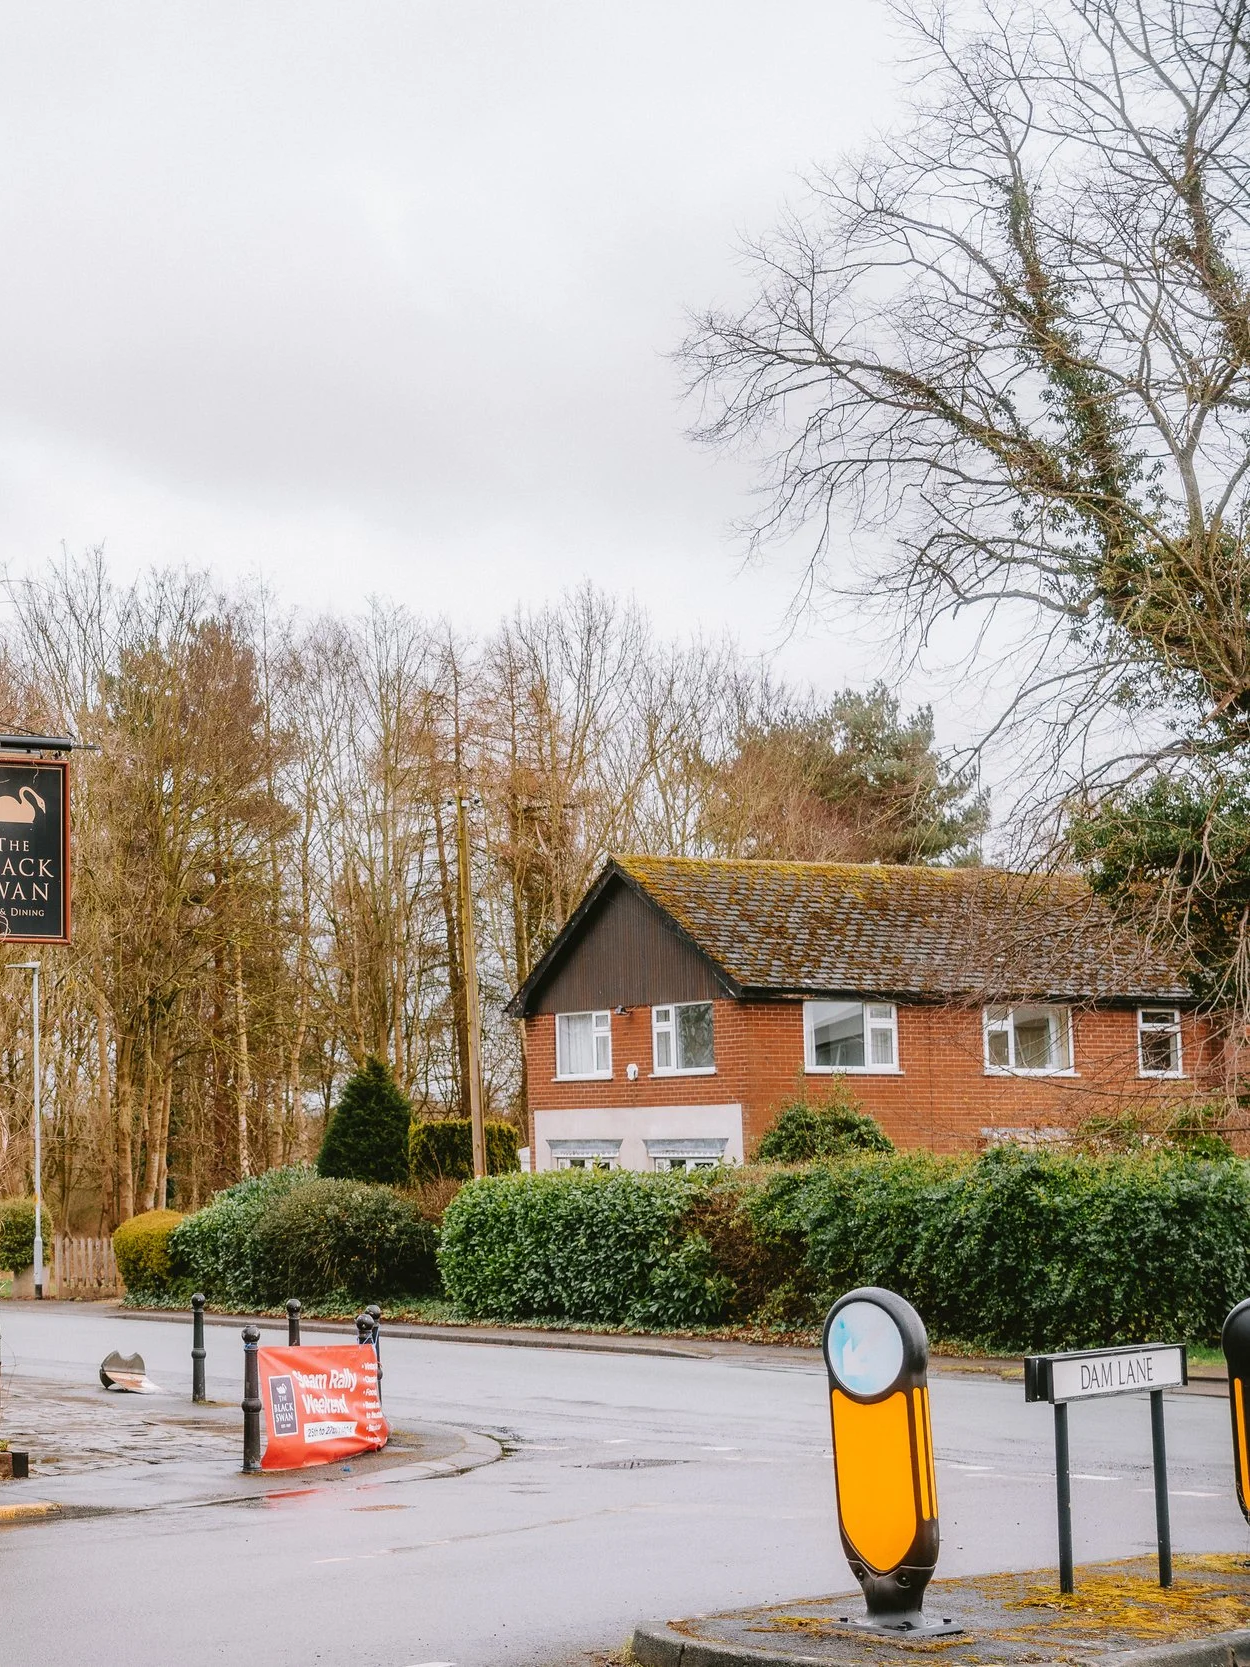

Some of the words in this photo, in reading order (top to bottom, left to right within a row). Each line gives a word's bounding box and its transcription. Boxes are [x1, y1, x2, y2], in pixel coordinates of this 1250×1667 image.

[0, 907, 7, 916] &
[11, 907, 45, 917] DINING
[329, 1368, 357, 1392] Rally
[1081, 1362, 1113, 1390] DAM
[1118, 1357, 1153, 1385] LANE
[274, 1402, 294, 1413] BLACK
[301, 1393, 349, 1415] Weekend
[275, 1412, 294, 1423] SWAN
